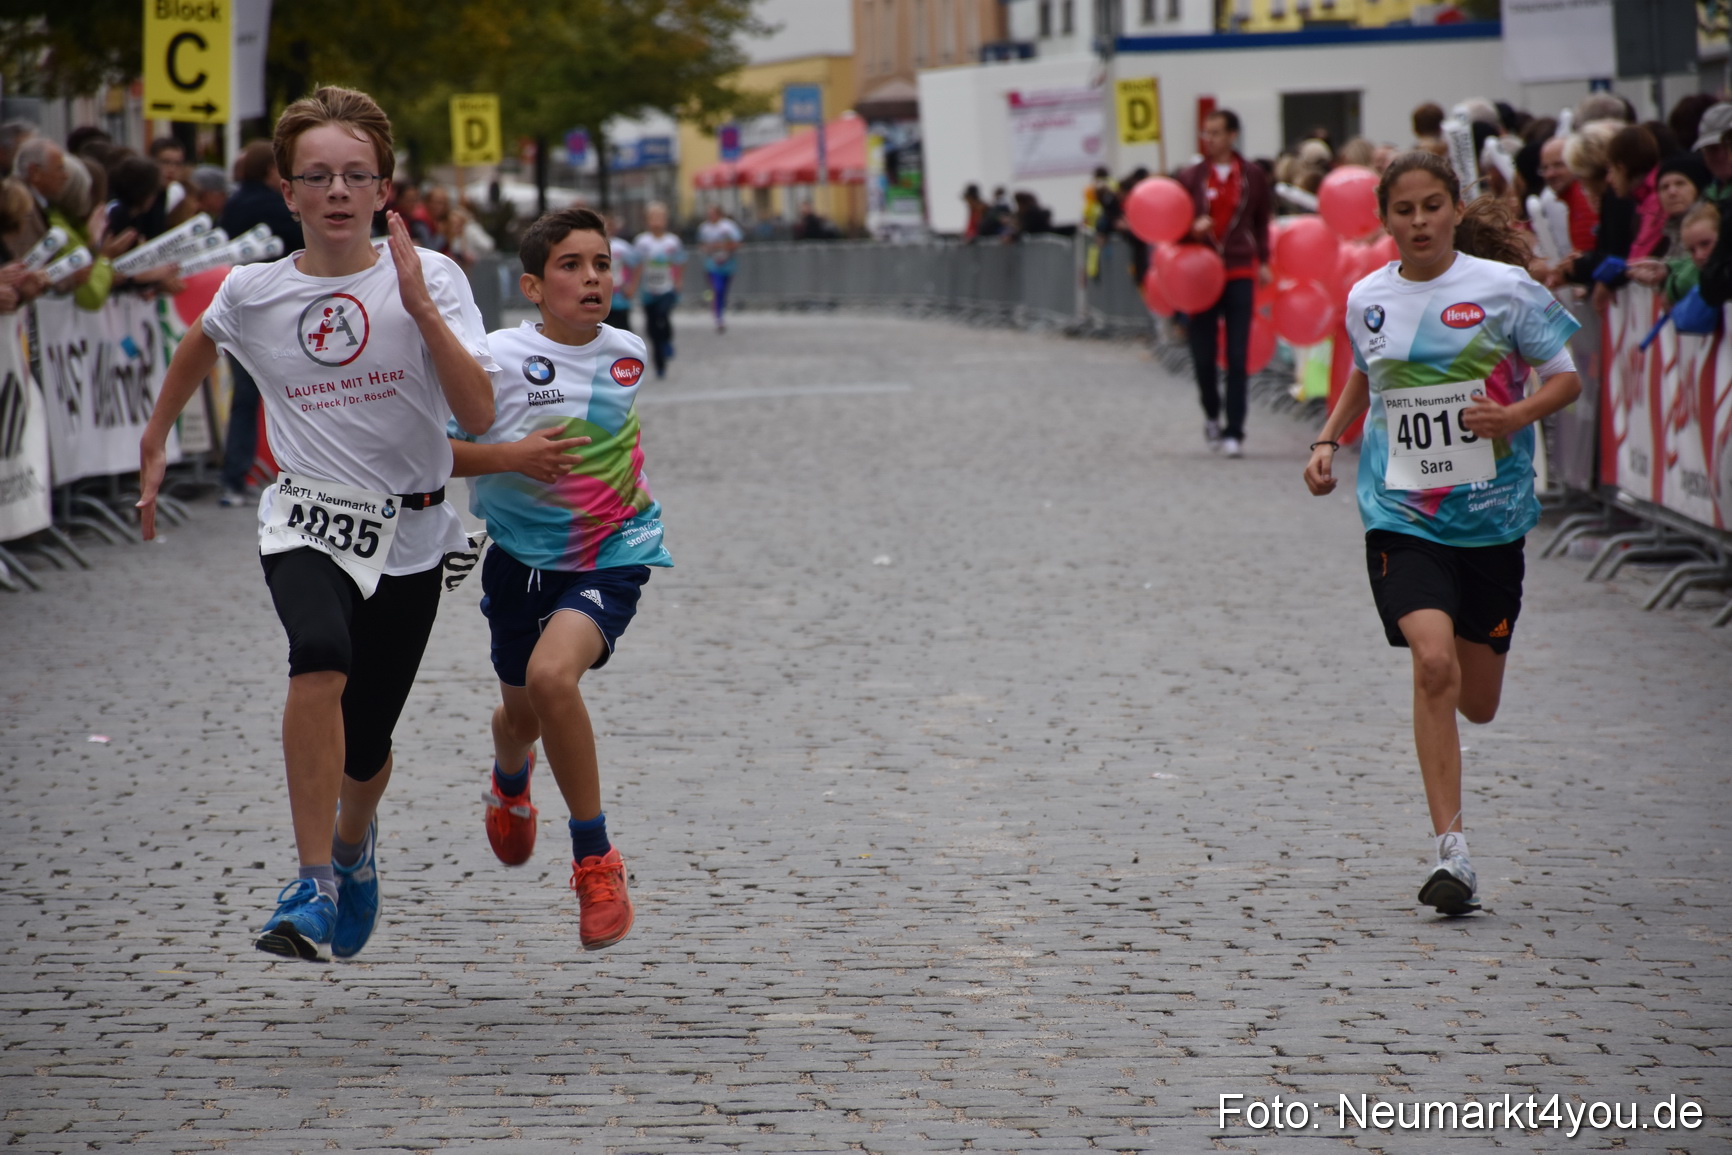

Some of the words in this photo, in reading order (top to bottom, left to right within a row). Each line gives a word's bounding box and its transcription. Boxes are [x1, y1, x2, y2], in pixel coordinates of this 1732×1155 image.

[156, 0, 221, 21] Block
[166, 30, 208, 92] C
[1128, 97, 1152, 130] D
[464, 117, 489, 151] D
[1446, 310, 1481, 322] Hervis
[301, 403, 315, 412] Dr.
[317, 398, 341, 410] Heck
[349, 395, 363, 405] Dr.
[365, 388, 397, 402] Röschl
[527, 389, 564, 401] PARTL
[529, 398, 565, 407] Neumarkt
[1386, 398, 1413, 409] PARTL
[1415, 393, 1467, 408] Neumarkt
[1420, 459, 1453, 475] Sara
[279, 484, 313, 500] PARTL
[316, 492, 377, 515] Neumarkt
